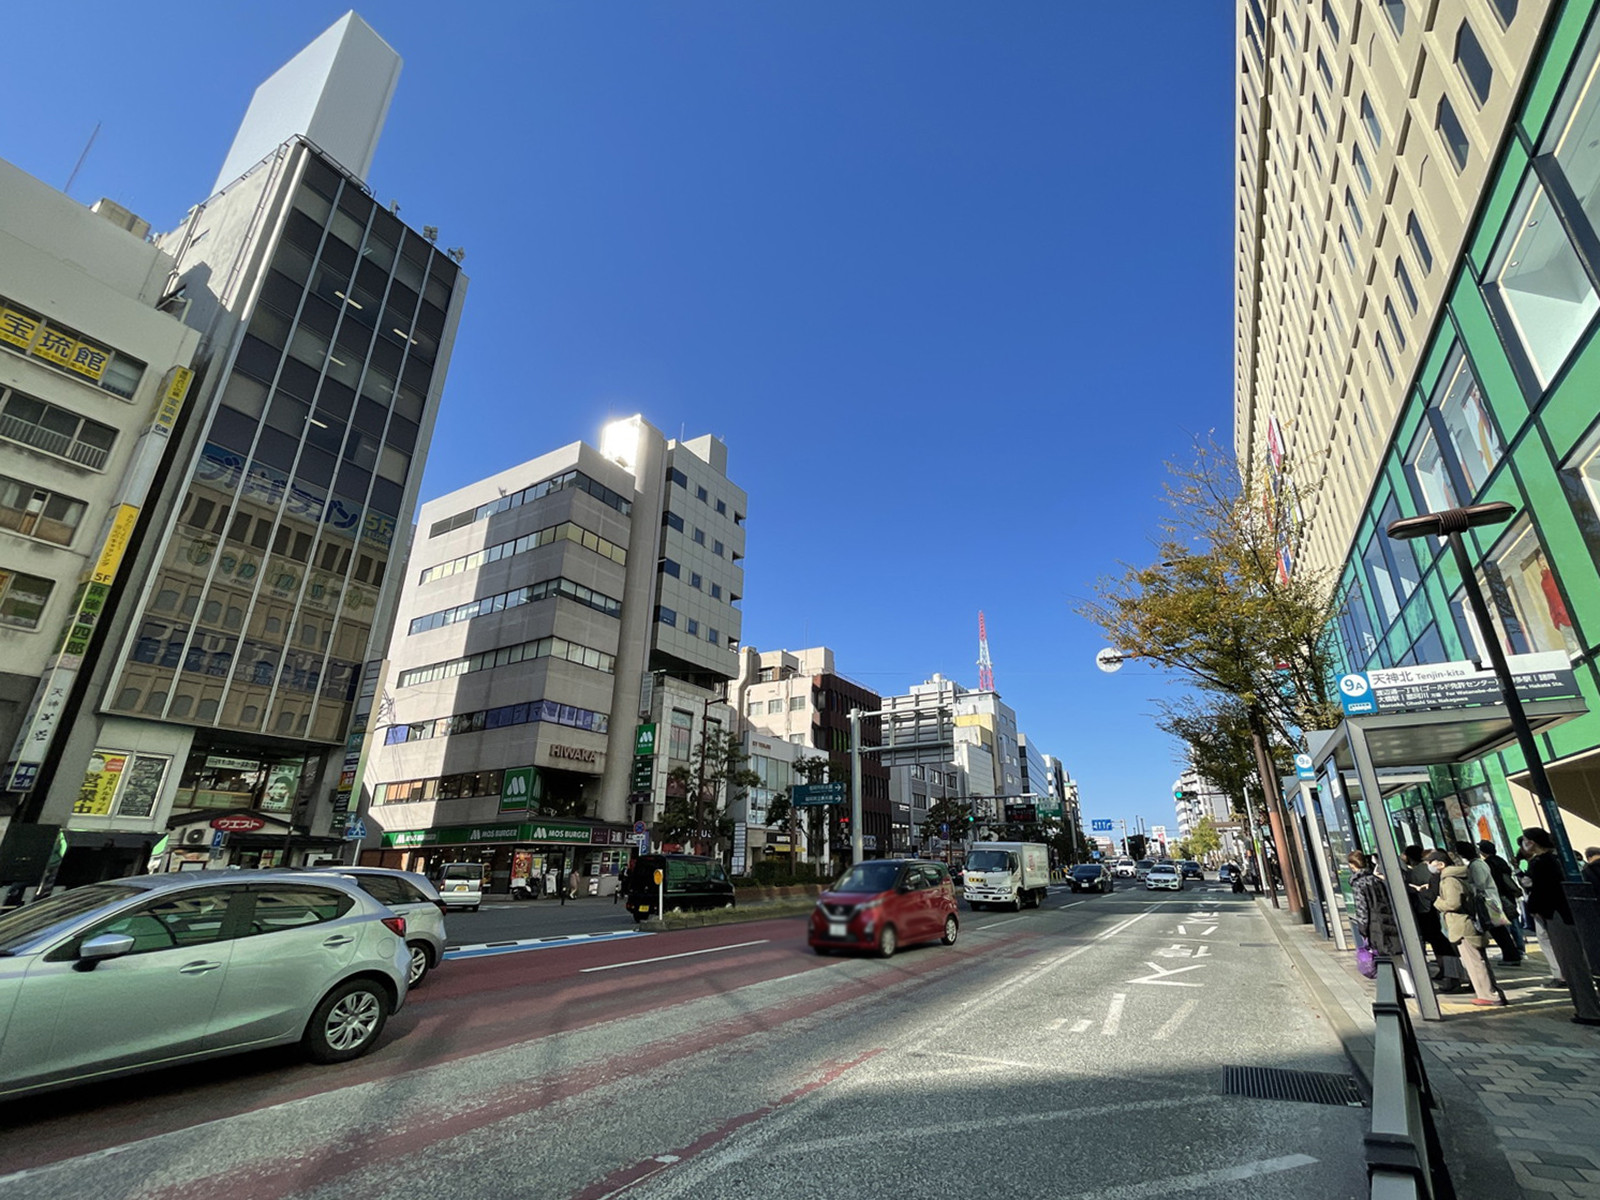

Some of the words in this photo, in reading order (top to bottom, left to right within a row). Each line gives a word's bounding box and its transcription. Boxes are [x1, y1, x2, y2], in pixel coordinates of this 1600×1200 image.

[1371, 670, 1414, 685] 天神北
[1416, 669, 1466, 681] Tenjin-kita
[1344, 679, 1364, 692] 9A
[218, 820, 260, 829] ウエスト
[213, 832, 222, 846] P
[495, 829, 518, 838] BURGER
[548, 830, 564, 838] MOS
[565, 830, 590, 838] BURGER
